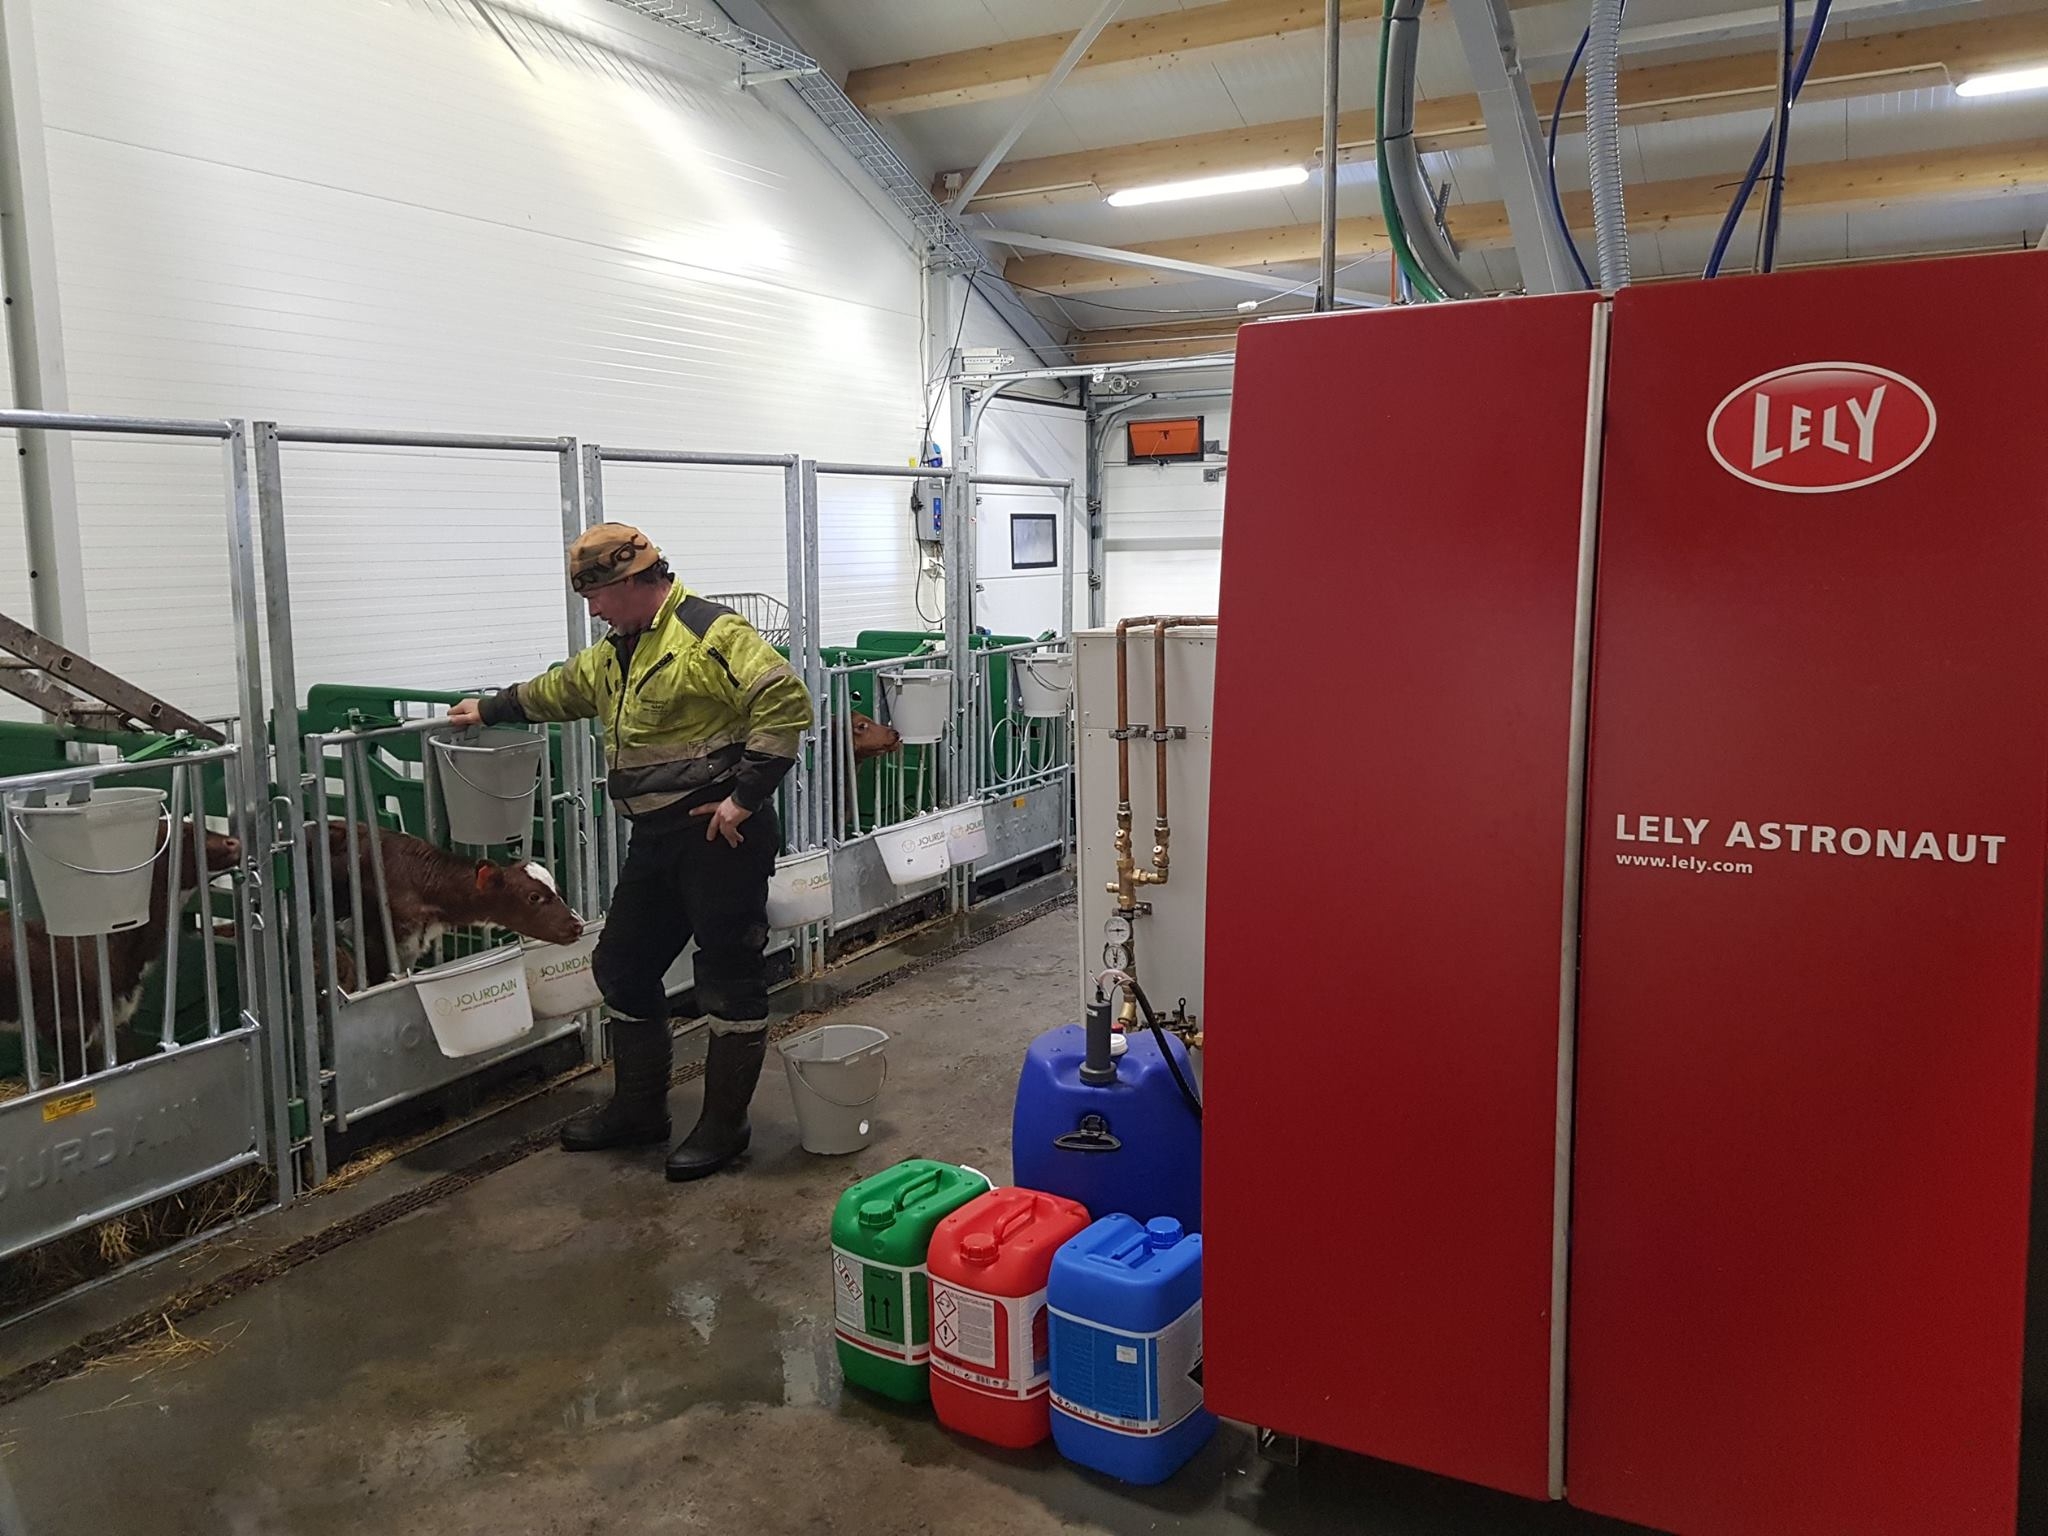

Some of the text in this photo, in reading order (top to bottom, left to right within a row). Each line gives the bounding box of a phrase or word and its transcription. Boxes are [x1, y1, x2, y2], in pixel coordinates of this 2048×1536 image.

[1752, 384, 1887, 470] LELY
[1616, 814, 2006, 865] LELY ASTRONAUT
[1616, 853, 1753, 875] www.lely.com
[539, 952, 592, 978] JOURDA
[454, 978, 517, 1008] JOURDAIN
